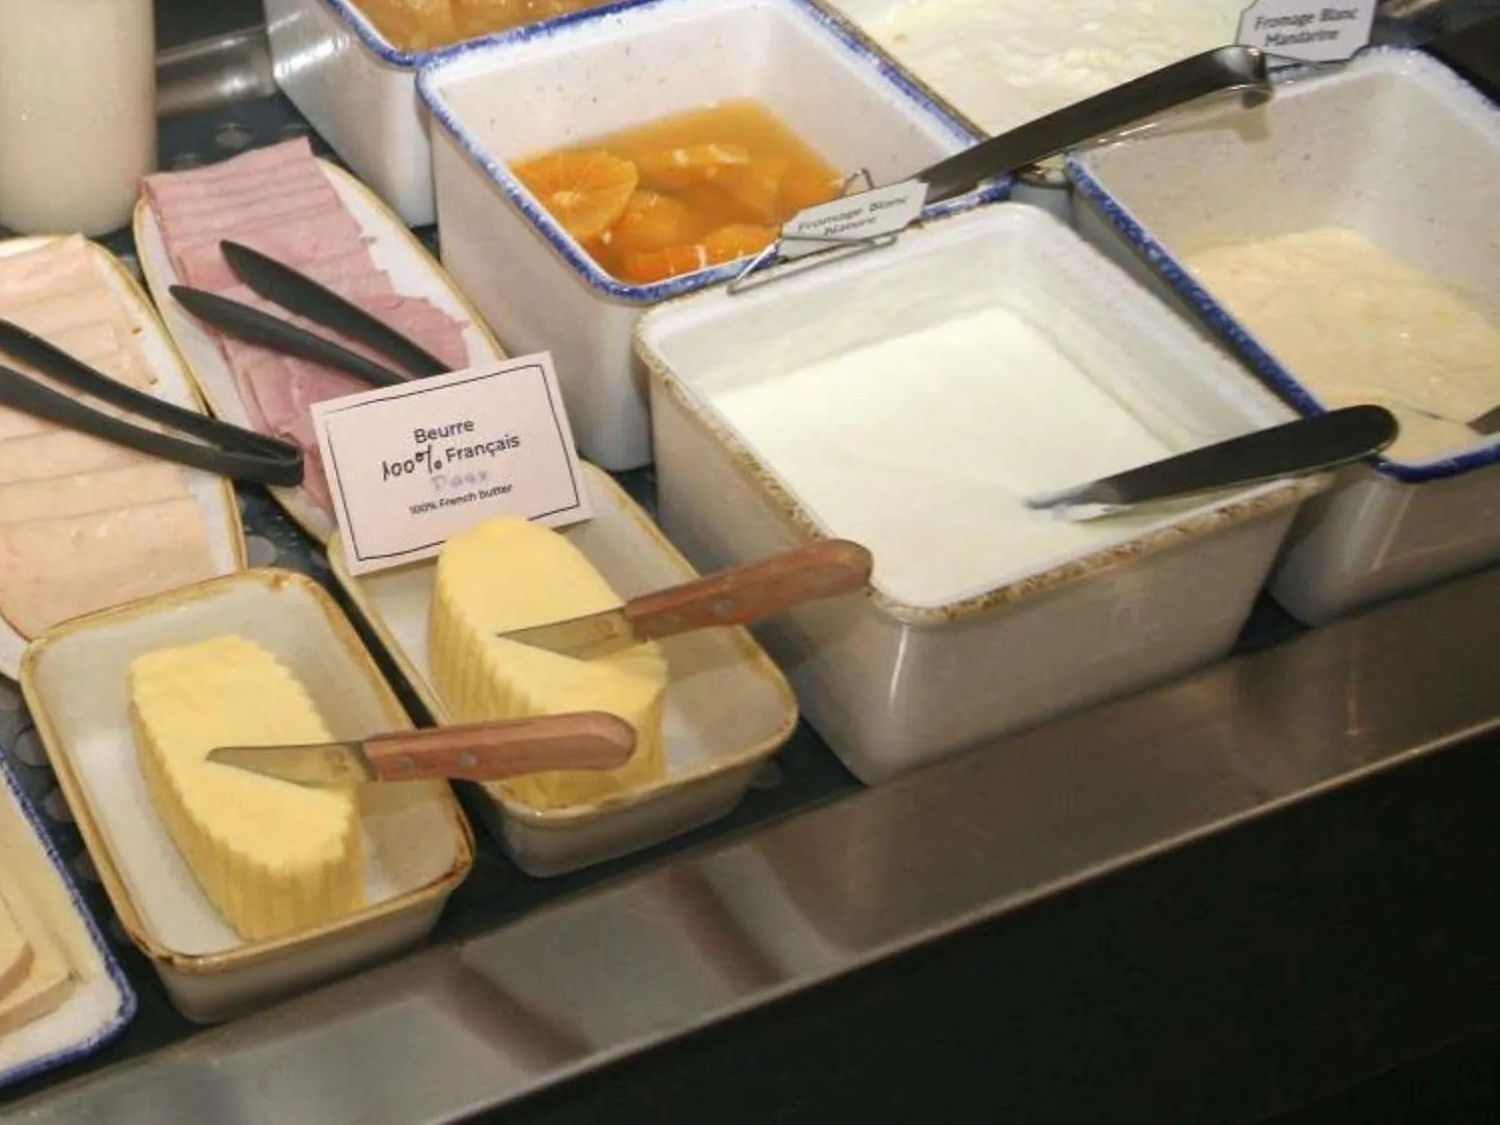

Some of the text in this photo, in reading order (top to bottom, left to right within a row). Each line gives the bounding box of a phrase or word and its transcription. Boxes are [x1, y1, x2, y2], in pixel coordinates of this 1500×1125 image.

[1254, 7, 1360, 31] Fromage Blanc
[1263, 30, 1340, 47] Mandarine
[797, 196, 908, 231] Fromage Blanc
[413, 420, 475, 444] Beurre
[382, 434, 521, 481] 100% Français
[409, 483, 513, 515] 100% French butter
